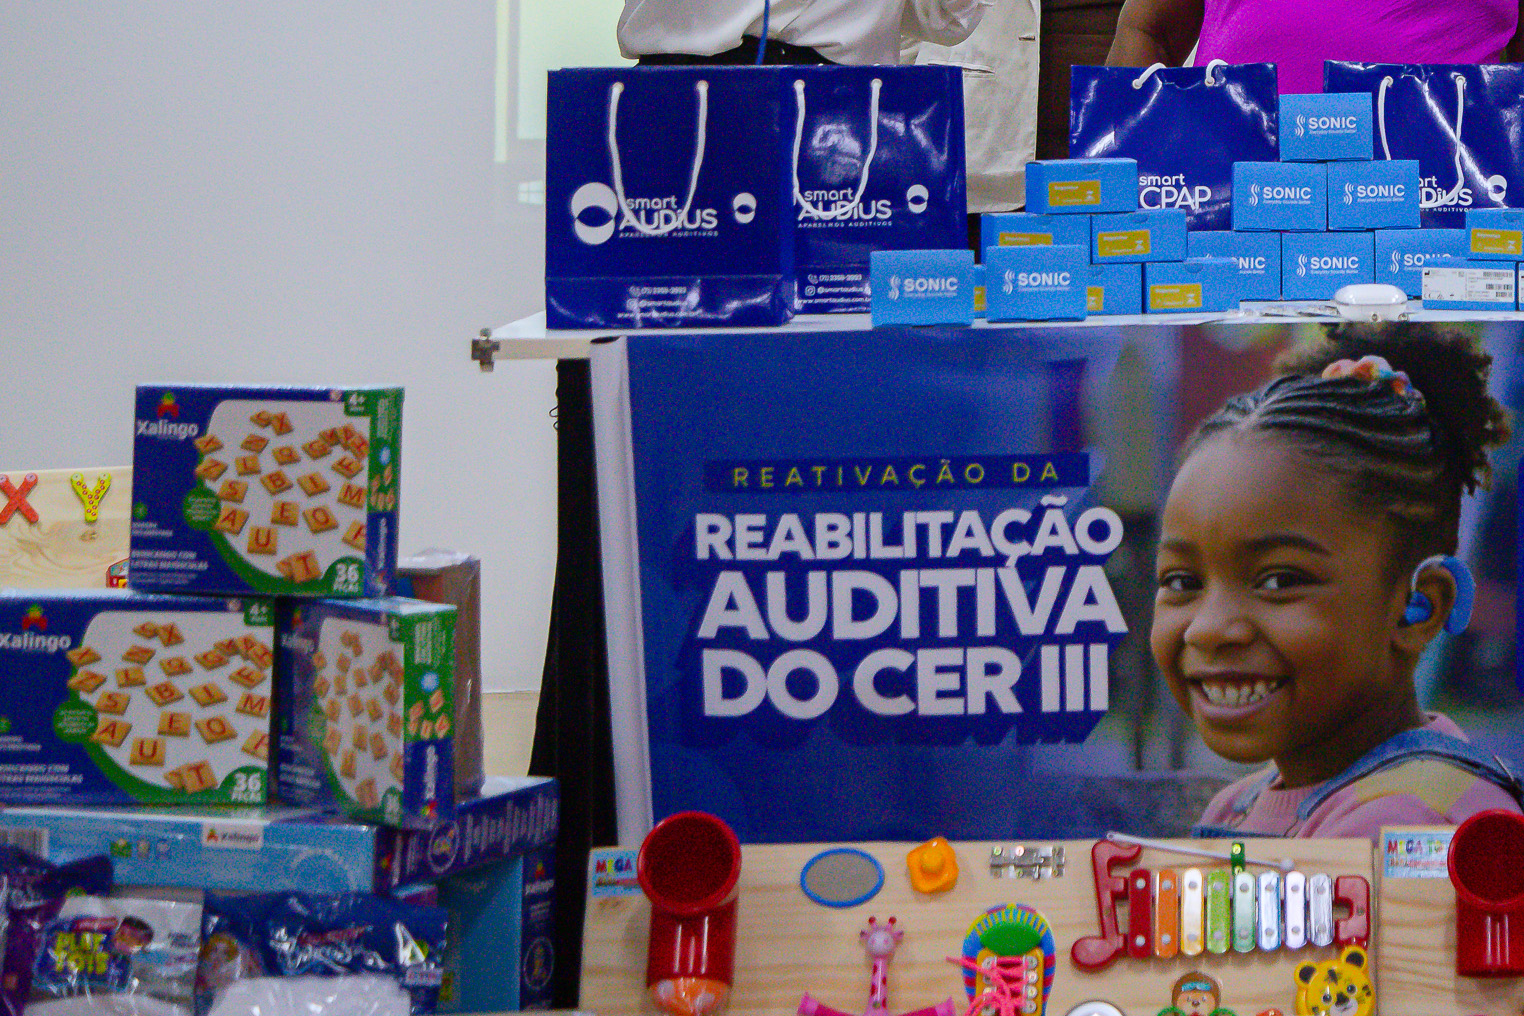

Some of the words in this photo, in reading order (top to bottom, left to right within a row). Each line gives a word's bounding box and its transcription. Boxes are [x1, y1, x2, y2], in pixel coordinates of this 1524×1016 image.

[1308, 117, 1357, 129] SONIC
[1139, 174, 1185, 185] smart
[804, 188, 853, 201] smart
[1139, 186, 1212, 211] CPAP
[1263, 187, 1311, 199] SONIC
[1357, 184, 1405, 198] SONIC
[627, 195, 677, 209] smart
[1310, 257, 1359, 270] SONIC
[903, 277, 958, 291] SONIC
[1018, 272, 1070, 286] SONIC
[137, 419, 198, 440] Xalingo
[734, 459, 985, 488] REATIVAÇÃO
[1013, 461, 1059, 483] DA
[0, 473, 39, 524] X
[71, 473, 111, 523] Y
[695, 494, 1124, 567] REABILITAÇÃO
[335, 564, 359, 582] 36
[698, 565, 1129, 641] AUDITIVA
[702, 648, 839, 719] DO
[853, 647, 1024, 715] CER
[1040, 643, 1109, 713] III
[233, 774, 261, 792] 36
